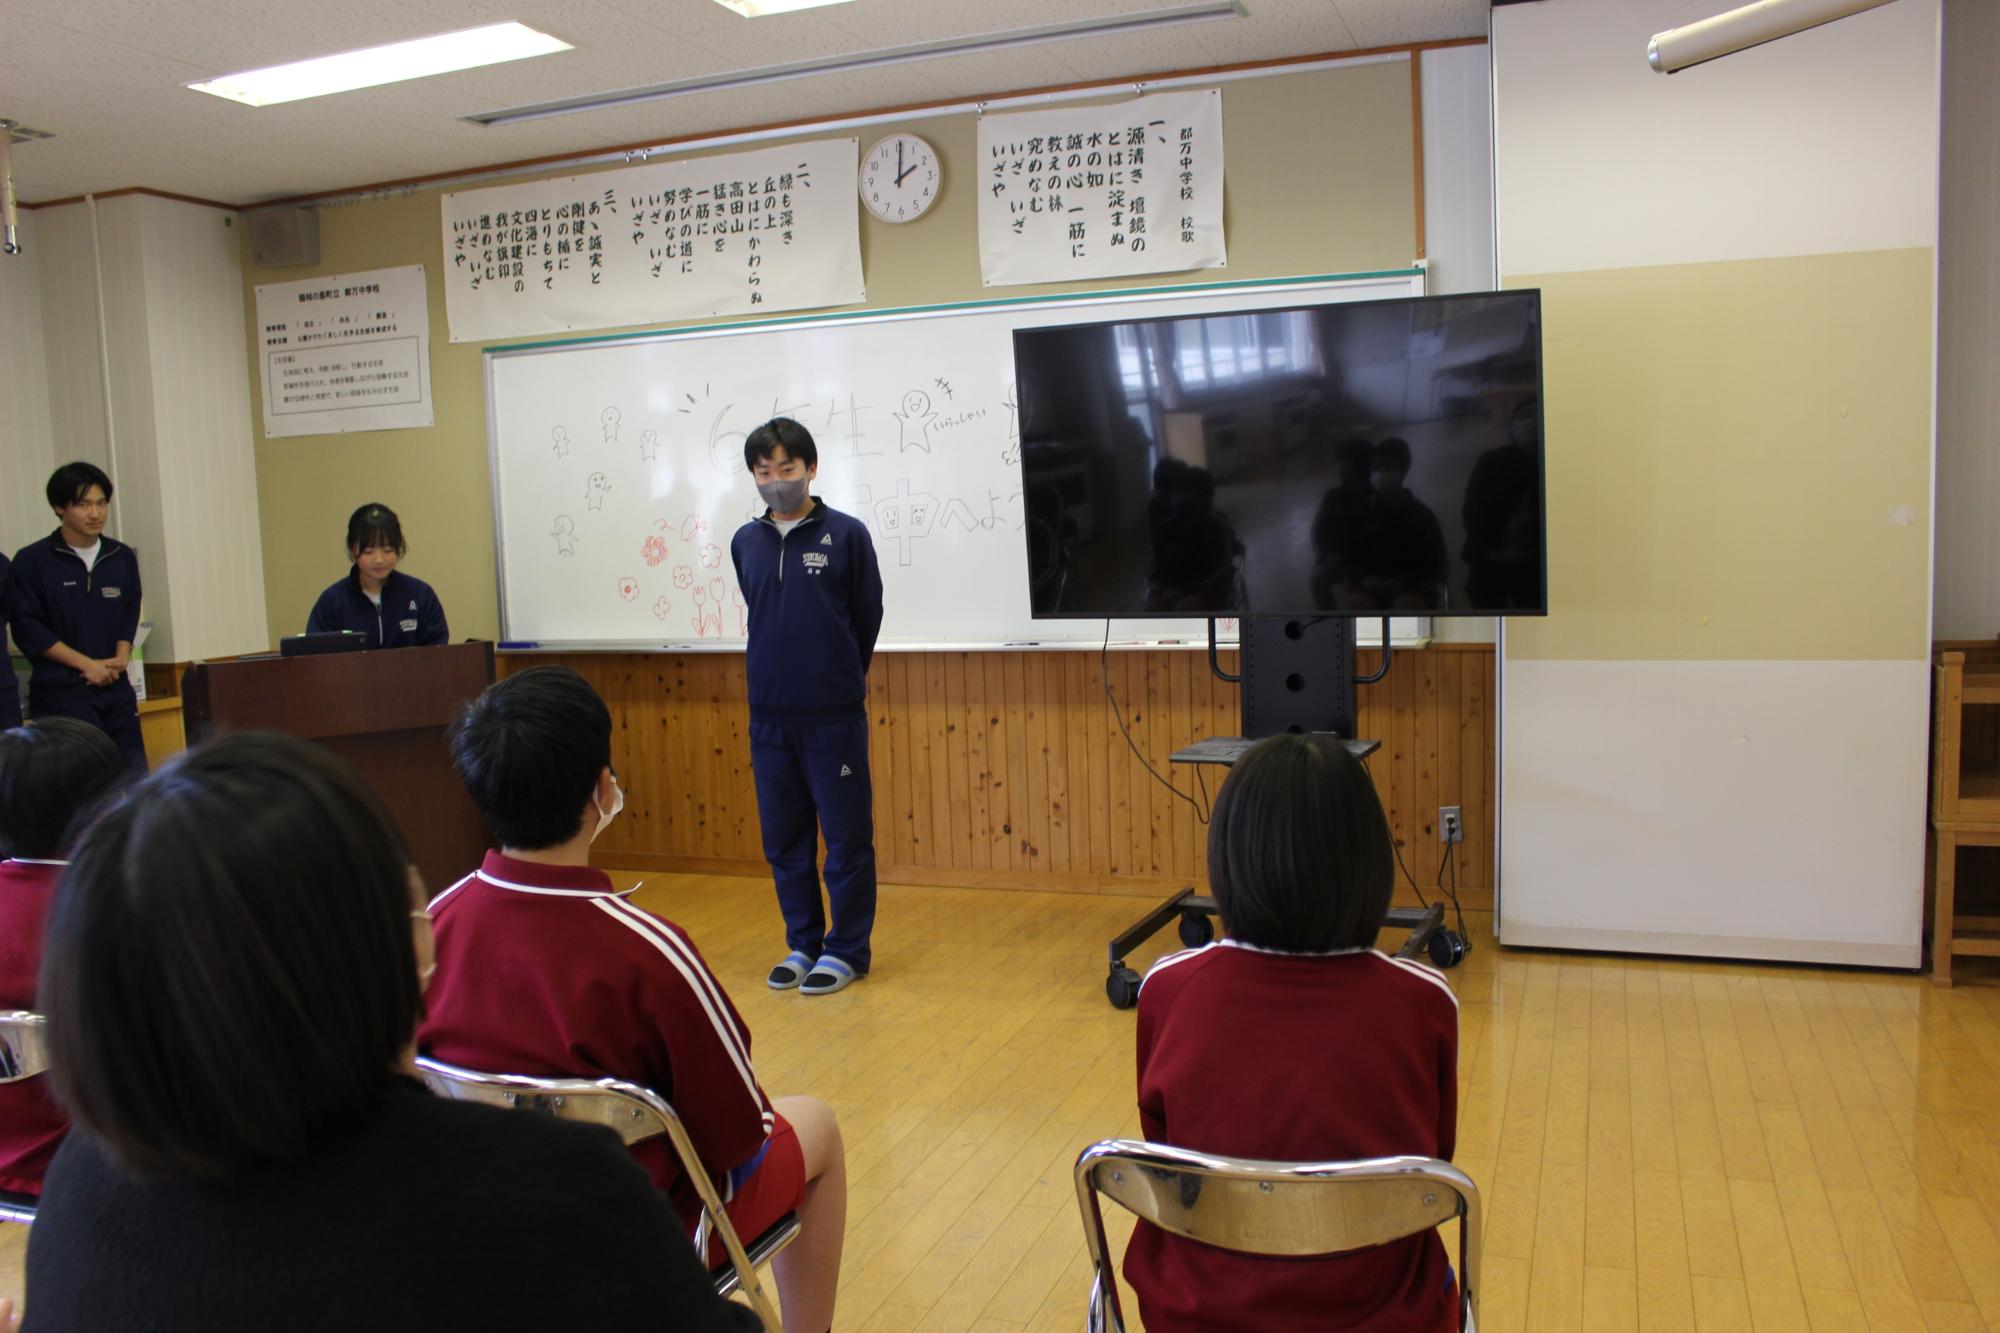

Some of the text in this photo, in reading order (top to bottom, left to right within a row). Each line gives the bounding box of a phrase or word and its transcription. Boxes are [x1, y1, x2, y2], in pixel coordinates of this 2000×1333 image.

[868, 177, 874, 187] 9
[870, 160, 879, 171] 10
[921, 155, 927, 166] 2
[927, 170, 933, 181] 3
[992, 144, 1007, 198] いざや
[1027, 137, 1044, 213] 究めなむ
[1086, 132, 1104, 188] 水の如
[1126, 127, 1145, 184] 源清き
[695, 189, 710, 236] 一筋に
[729, 181, 744, 233] 高田山
[763, 176, 777, 230] 丘の上
[779, 172, 794, 245] 緑も深き
[873, 192, 880, 202] 8
[885, 202, 891, 213] 7
[898, 206, 905, 217] 6
[913, 199, 919, 210] 5
[923, 187, 929, 197] 4
[1010, 142, 1026, 234] いざ いざ
[1066, 134, 1085, 258] 誠の心 一筋に
[1107, 132, 1125, 246] とはに淀まぬ
[453, 220, 467, 267] いざや
[525, 208, 538, 257] 四海に
[571, 202, 585, 252] 剛健を
[631, 196, 645, 246] いざや
[648, 193, 663, 278] いざ いざ
[663, 189, 677, 259] 努めなむ
[679, 186, 693, 274] 学びの道に
[712, 183, 728, 253] 猛き心を
[748, 181, 763, 305] とはにかわらぬ
[1180, 216, 1195, 242] 校歌
[467, 219, 483, 290] いざ いざ
[480, 214, 495, 281] 進めなむ
[495, 212, 510, 279] 我が旗印
[510, 211, 524, 293] 文化建設の
[540, 207, 553, 290] とりもちて
